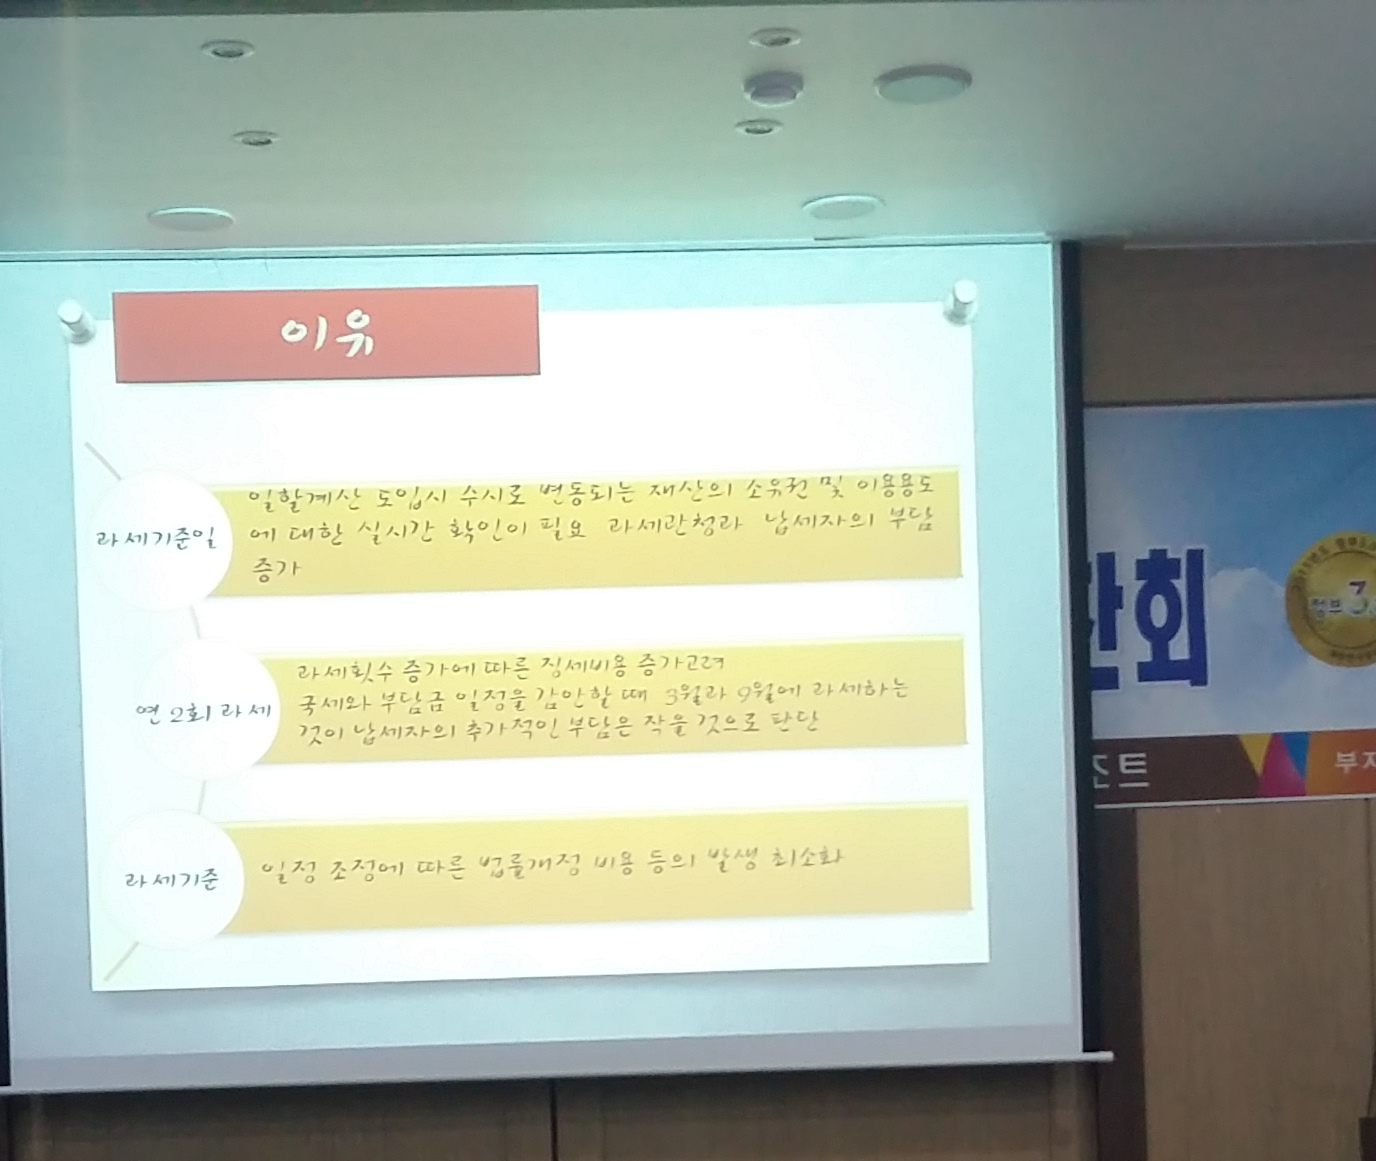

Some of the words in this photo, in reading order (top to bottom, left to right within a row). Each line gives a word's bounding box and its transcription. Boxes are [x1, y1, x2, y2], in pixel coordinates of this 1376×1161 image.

[281, 308, 374, 357] 이유
[248, 487, 362, 514] 일할계산
[376, 485, 447, 511] 도입시
[459, 484, 527, 508] 수시로
[539, 480, 635, 507] 변동되는
[649, 479, 733, 503] 재산의
[746, 476, 808, 500] 소유권
[857, 472, 934, 498] 이용용도
[249, 527, 277, 543] 에
[288, 521, 344, 547] 대한
[357, 519, 435, 546] 실시간
[449, 517, 527, 544] 확인이
[539, 516, 587, 542] 필요
[764, 509, 874, 536] 납세자의
[889, 505, 933, 532] 부담
[252, 557, 301, 584] 증가
[402, 659, 476, 684] 증가에
[484, 656, 531, 681] 따른
[135, 703, 161, 726] 연
[169, 702, 212, 723] 2회
[298, 694, 373, 717] 국세와
[380, 690, 446, 715] 부담금
[455, 688, 527, 712] 일정을
[535, 685, 613, 710] 감안할
[621, 688, 648, 702] 때
[299, 724, 344, 746] 것이
[353, 721, 456, 746] 납세자의
[466, 717, 559, 743] 추가적인
[568, 715, 633, 740] 부담은
[644, 713, 689, 738] 작을
[697, 712, 760, 736] 것으로
[261, 860, 316, 885] 일정
[330, 858, 405, 883] 조정에
[416, 855, 466, 881] 따른
[479, 853, 581, 880] 법률개정
[594, 850, 634, 876] 비용
[647, 849, 695, 875] 등의
[707, 847, 759, 874] 발생
[772, 847, 843, 867] 최소화
